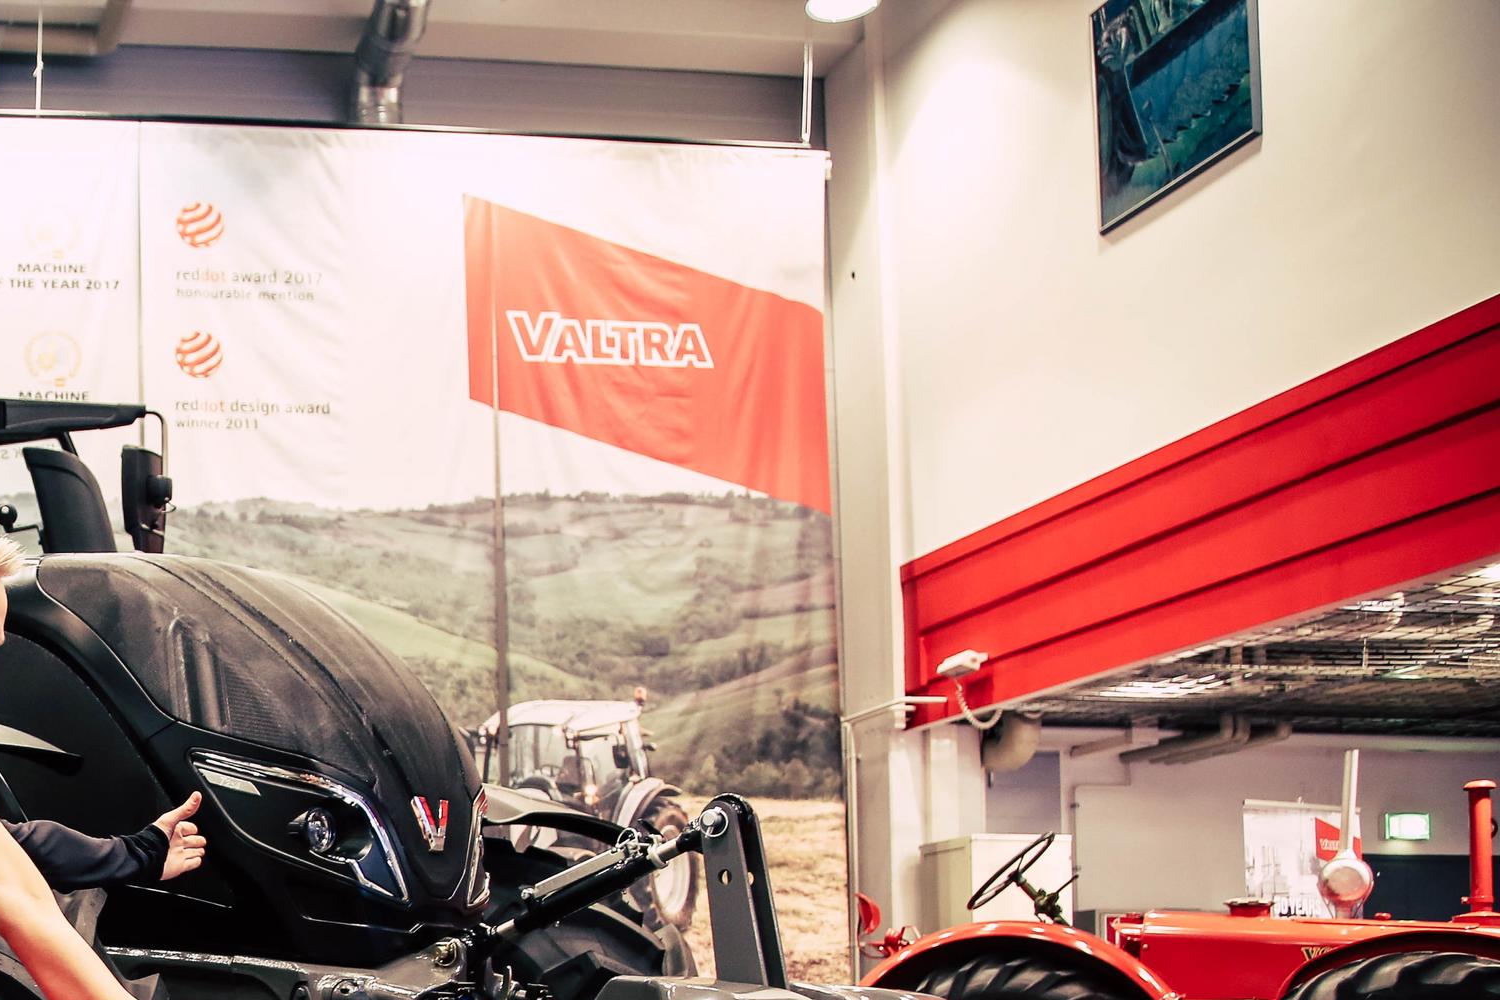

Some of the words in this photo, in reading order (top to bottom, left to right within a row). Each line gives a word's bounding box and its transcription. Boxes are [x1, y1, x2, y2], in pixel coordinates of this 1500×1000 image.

[17, 263, 88, 274] MACHINE
[231, 270, 278, 284] award
[283, 271, 322, 285] 2017
[10, 279, 36, 289] THE
[42, 279, 80, 289] YEAR
[85, 279, 120, 290] 2017
[176, 287, 253, 300] honourable
[258, 289, 315, 301] mention
[505, 309, 715, 369] VALTRA
[19, 390, 90, 401] MACHINE
[230, 400, 280, 416] design
[285, 402, 331, 415] award
[175, 417, 222, 429] winner
[225, 417, 260, 430] 2011
